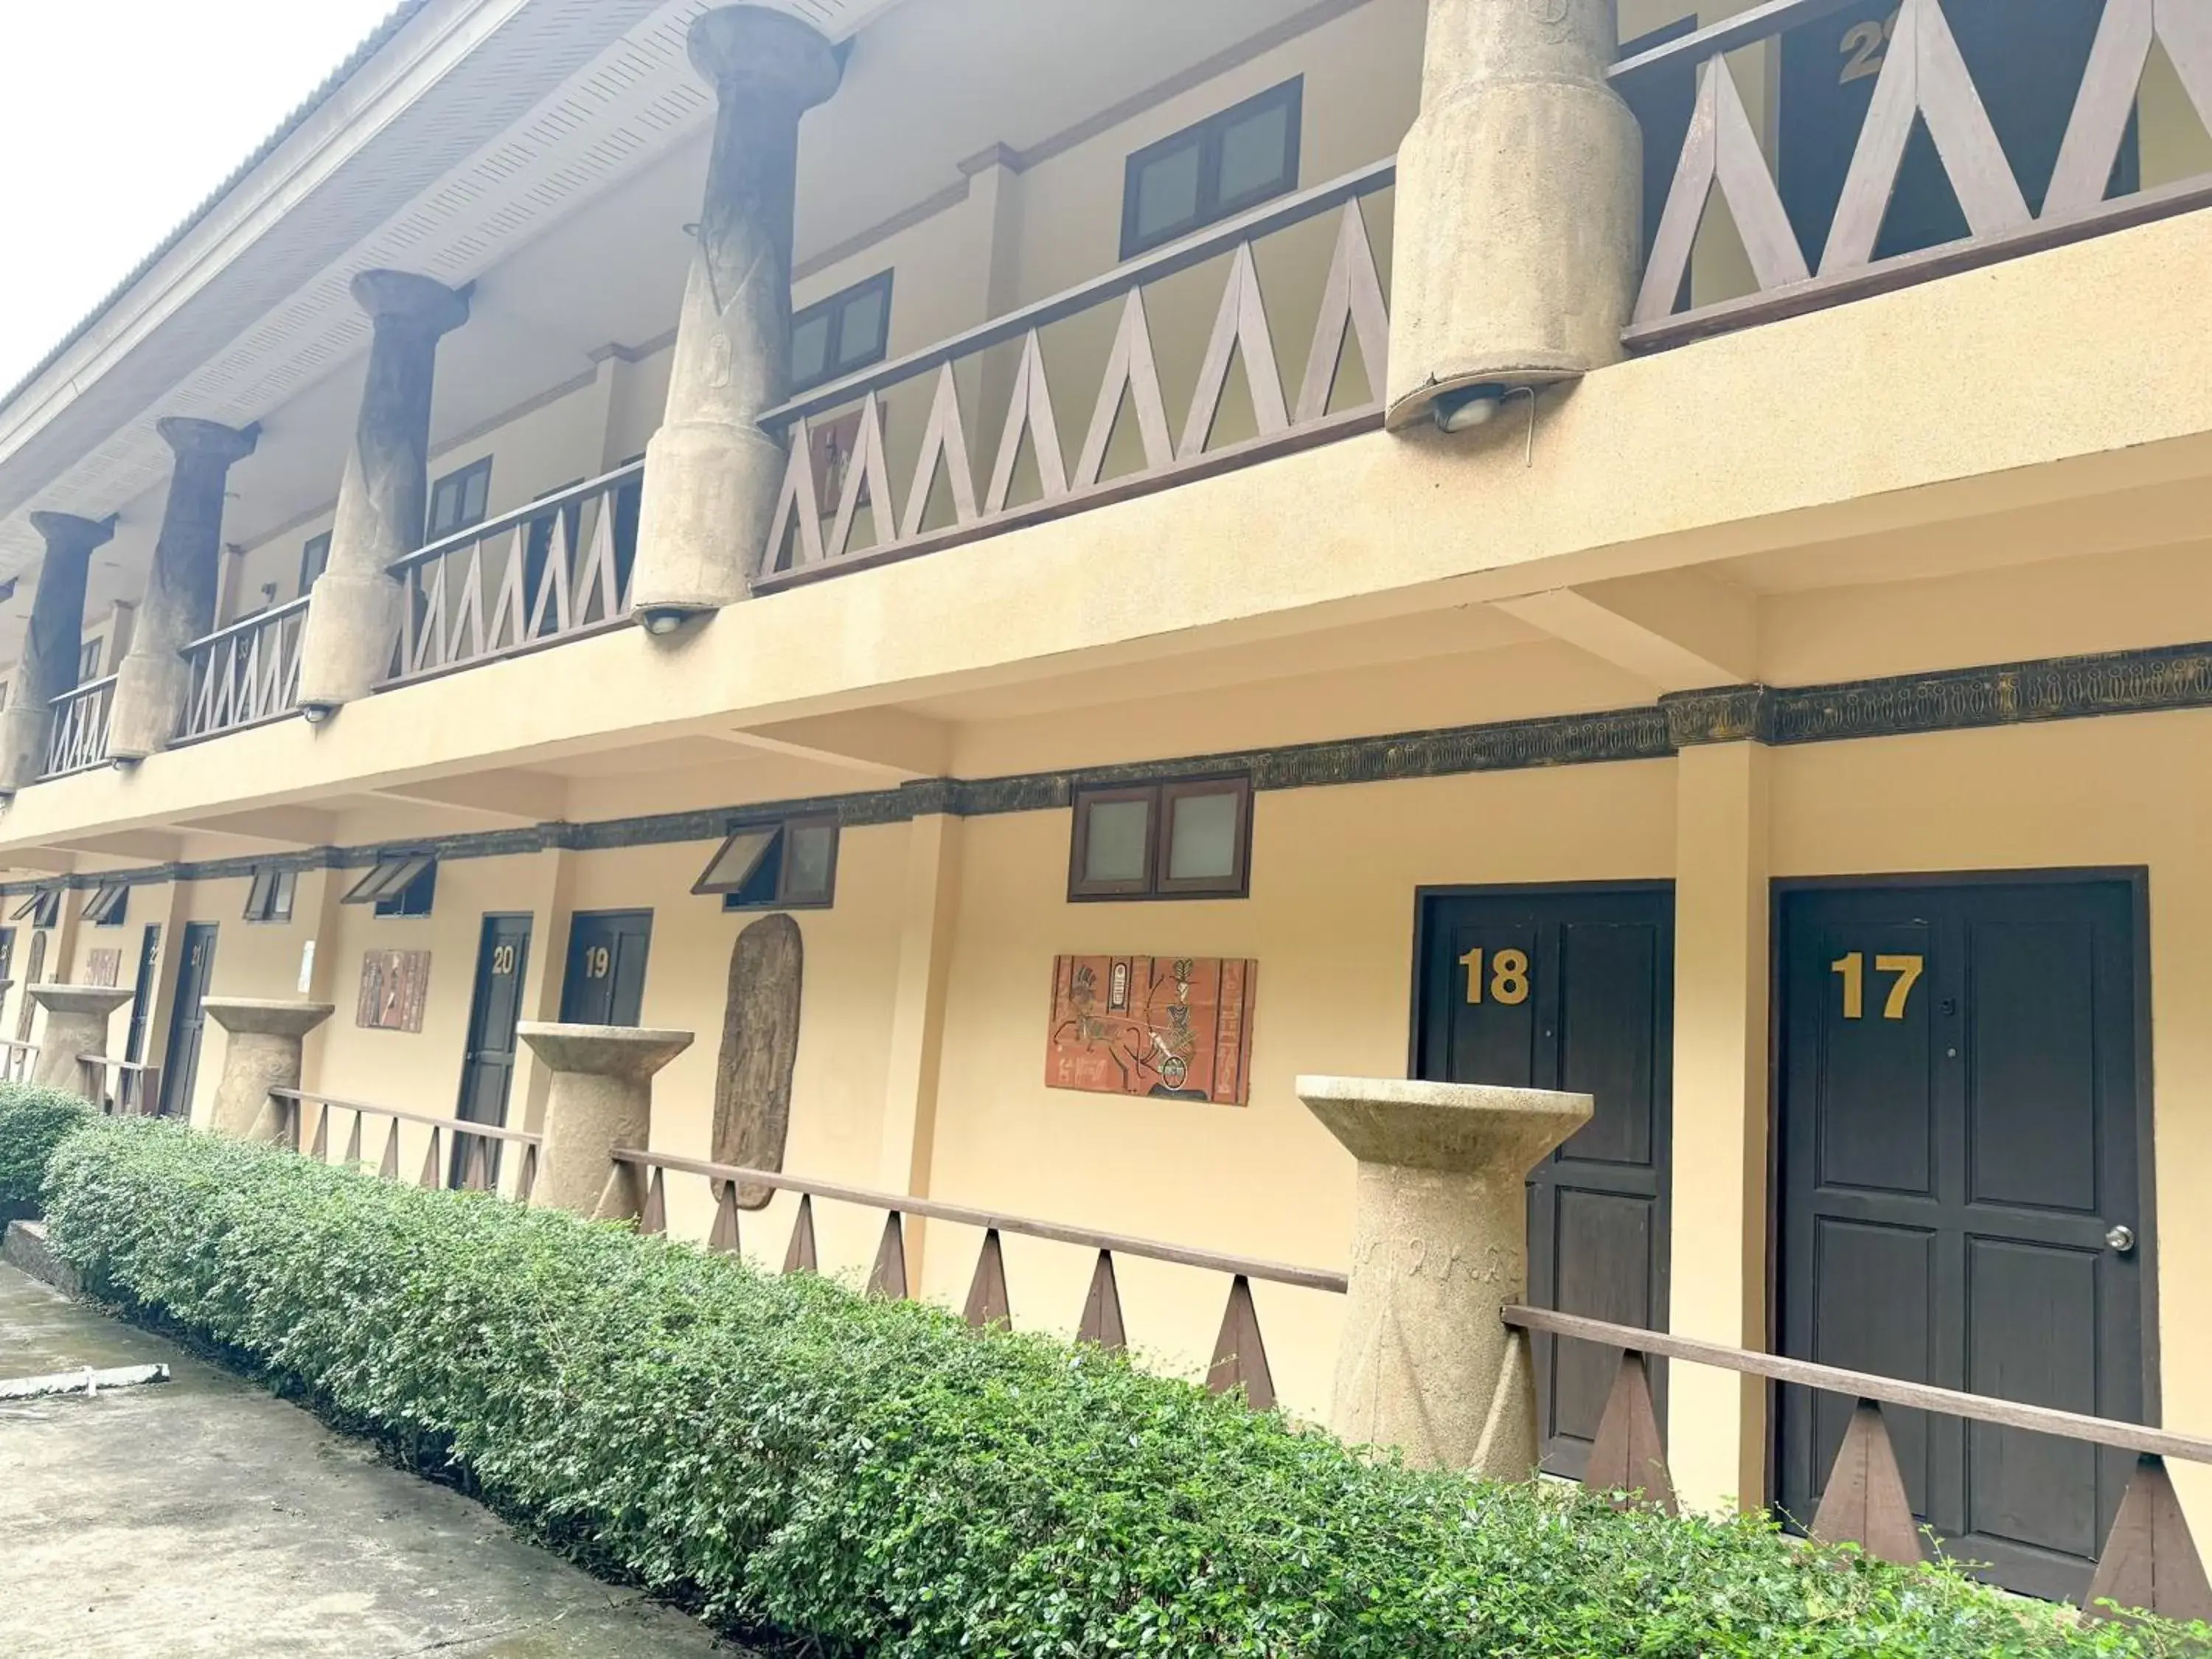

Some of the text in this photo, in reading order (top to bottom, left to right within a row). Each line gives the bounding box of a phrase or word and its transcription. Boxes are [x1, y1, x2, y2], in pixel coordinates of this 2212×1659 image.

[492, 945, 514, 974] 20
[586, 945, 610, 978] 19
[1458, 947, 1529, 1005] 18
[1831, 951, 1924, 1020] 17
